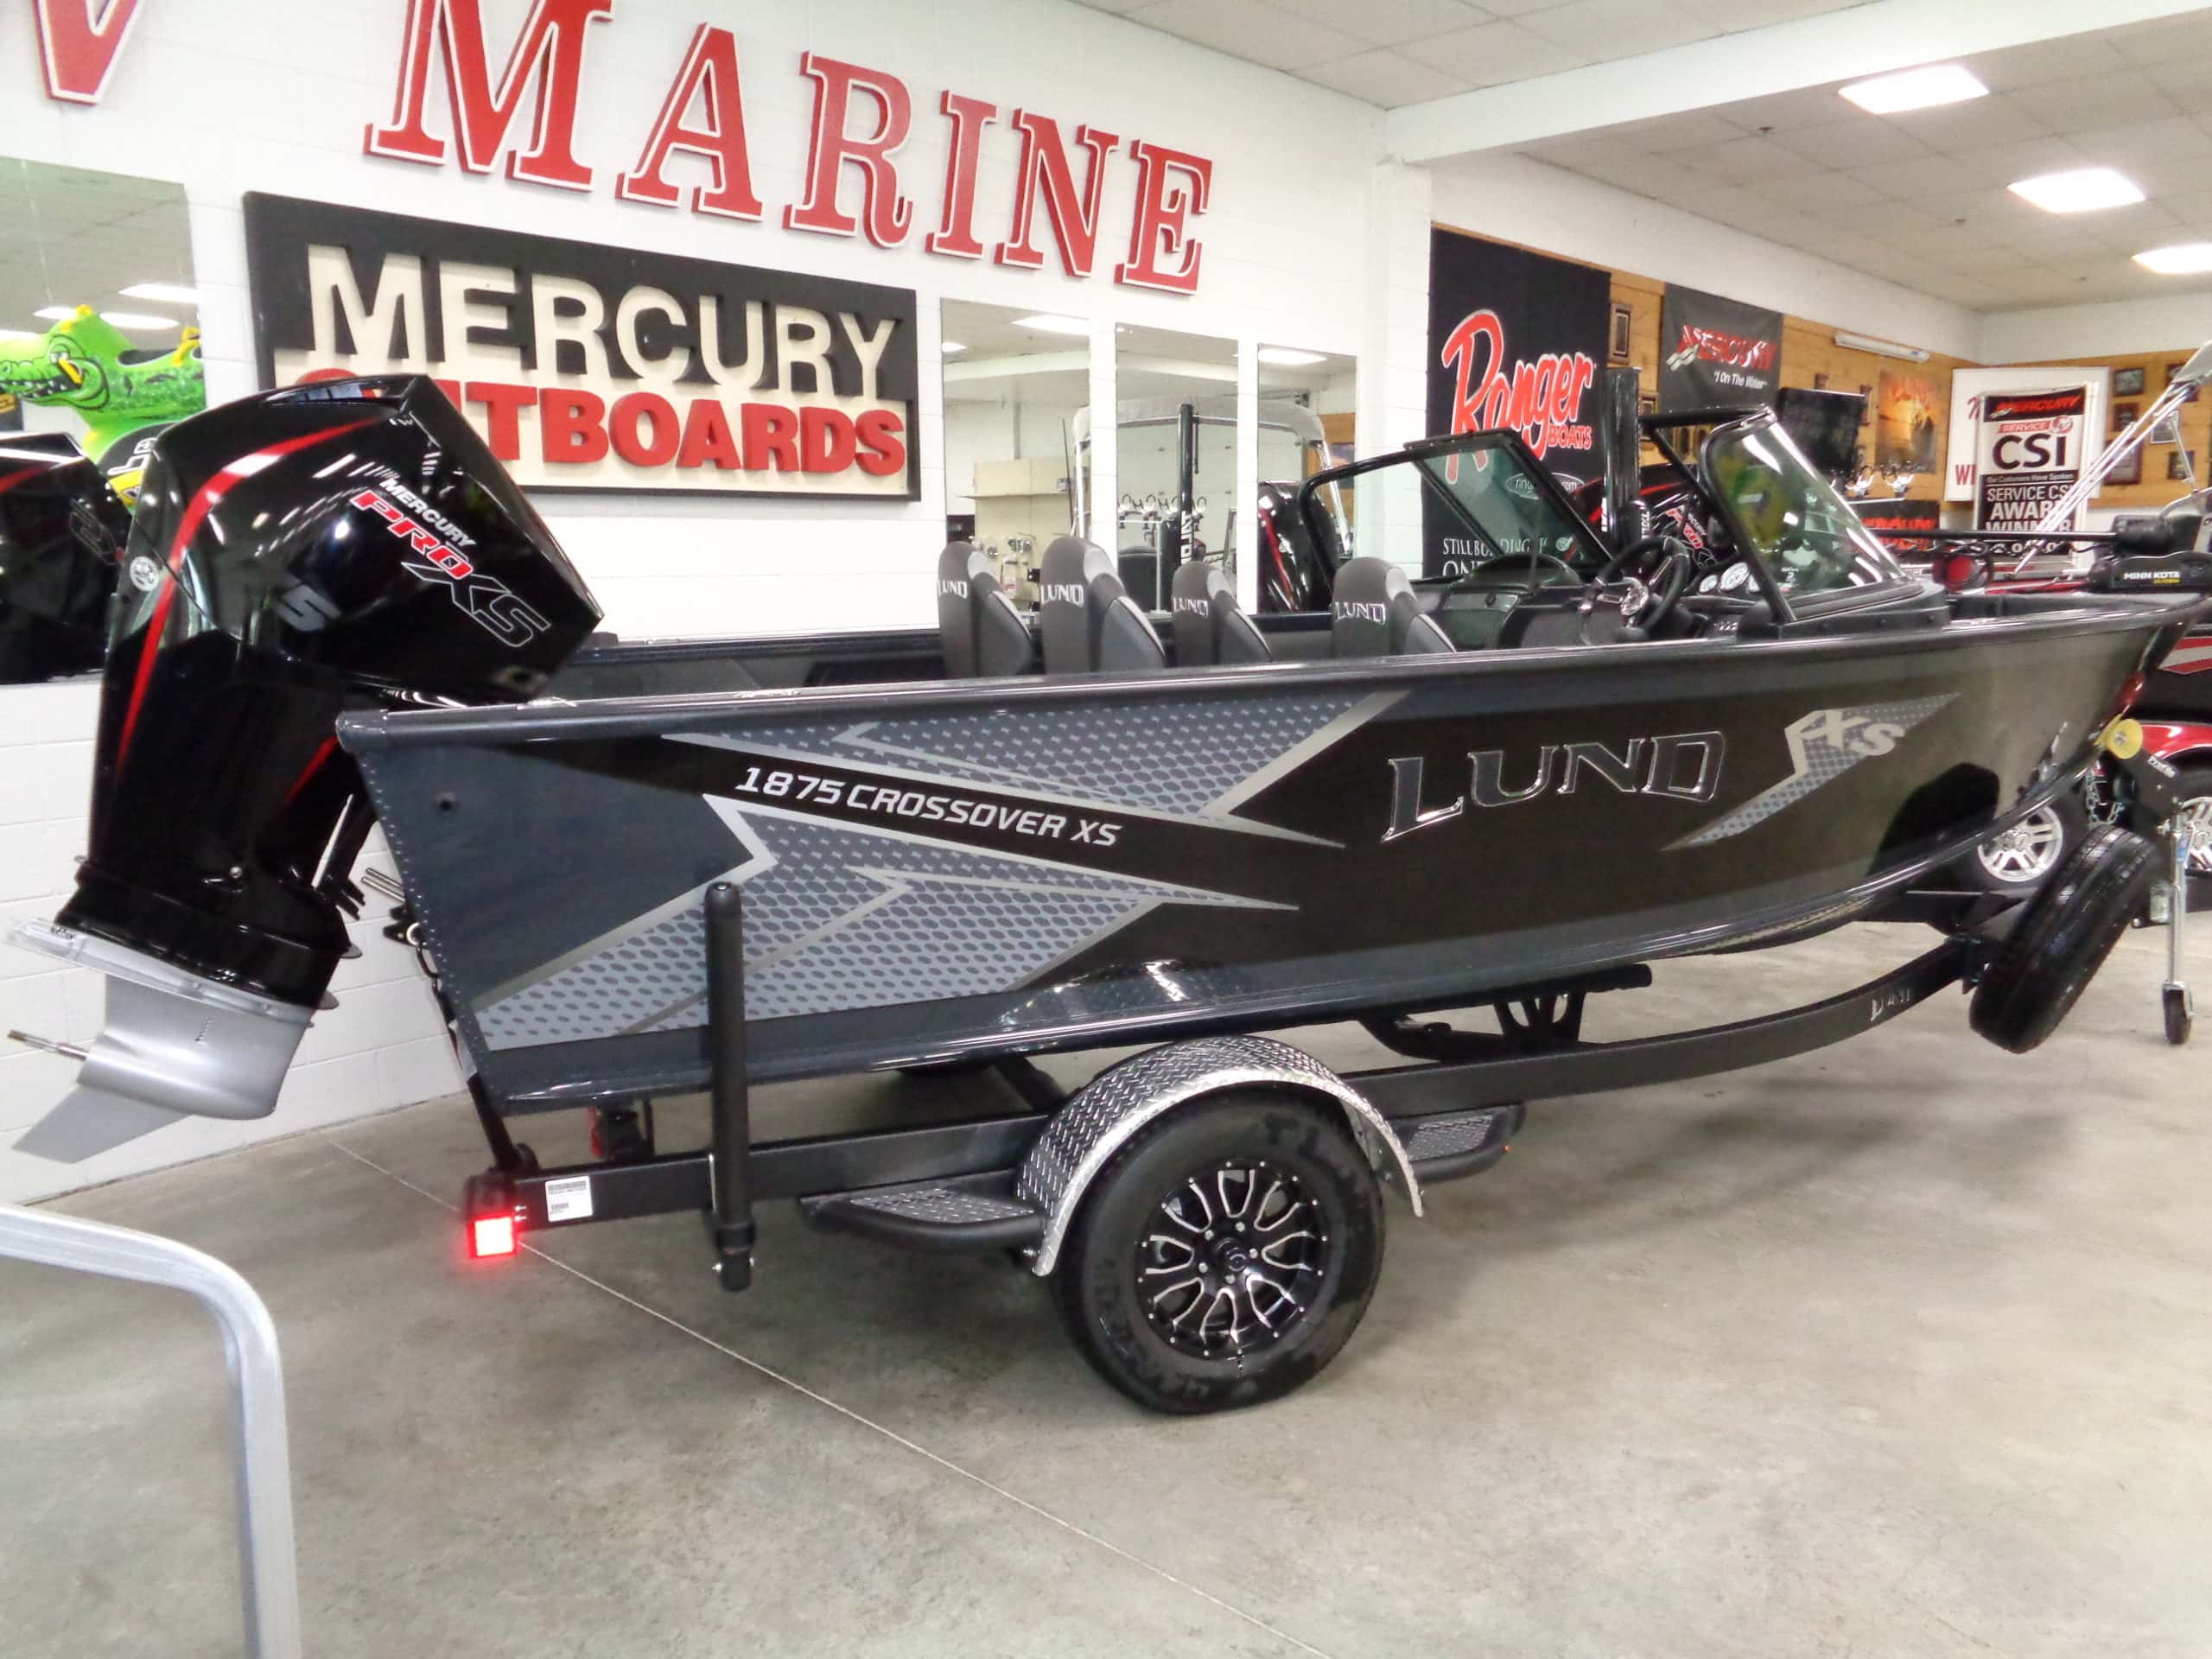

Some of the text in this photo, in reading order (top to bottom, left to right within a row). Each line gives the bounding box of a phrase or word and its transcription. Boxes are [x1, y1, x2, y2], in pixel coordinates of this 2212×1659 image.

[363, 0, 1213, 296] MARINE
[307, 243, 902, 399] MERCURY
[1441, 308, 1592, 483] Ranger
[295, 368, 906, 476] TBOARDS
[1548, 424, 1592, 450] BOATS
[2002, 423, 2048, 432] SERVICE
[1993, 433, 2066, 469] CSI
[1987, 486, 2045, 501] SERVICE
[379, 477, 476, 547] MERCURY
[1990, 501, 2059, 520] AWAR
[349, 490, 474, 580] PRO
[1443, 537, 1472, 556] STILL
[937, 580, 968, 599] LUND
[2153, 570, 2180, 579] KOTA
[400, 561, 551, 647] XS
[1039, 584, 1084, 607] LUND
[1173, 597, 1209, 619] LUND
[1334, 601, 1386, 626] LUND
[1382, 730, 1726, 842] LUND
[734, 766, 1122, 848] 1875 CROSSOVER XS
